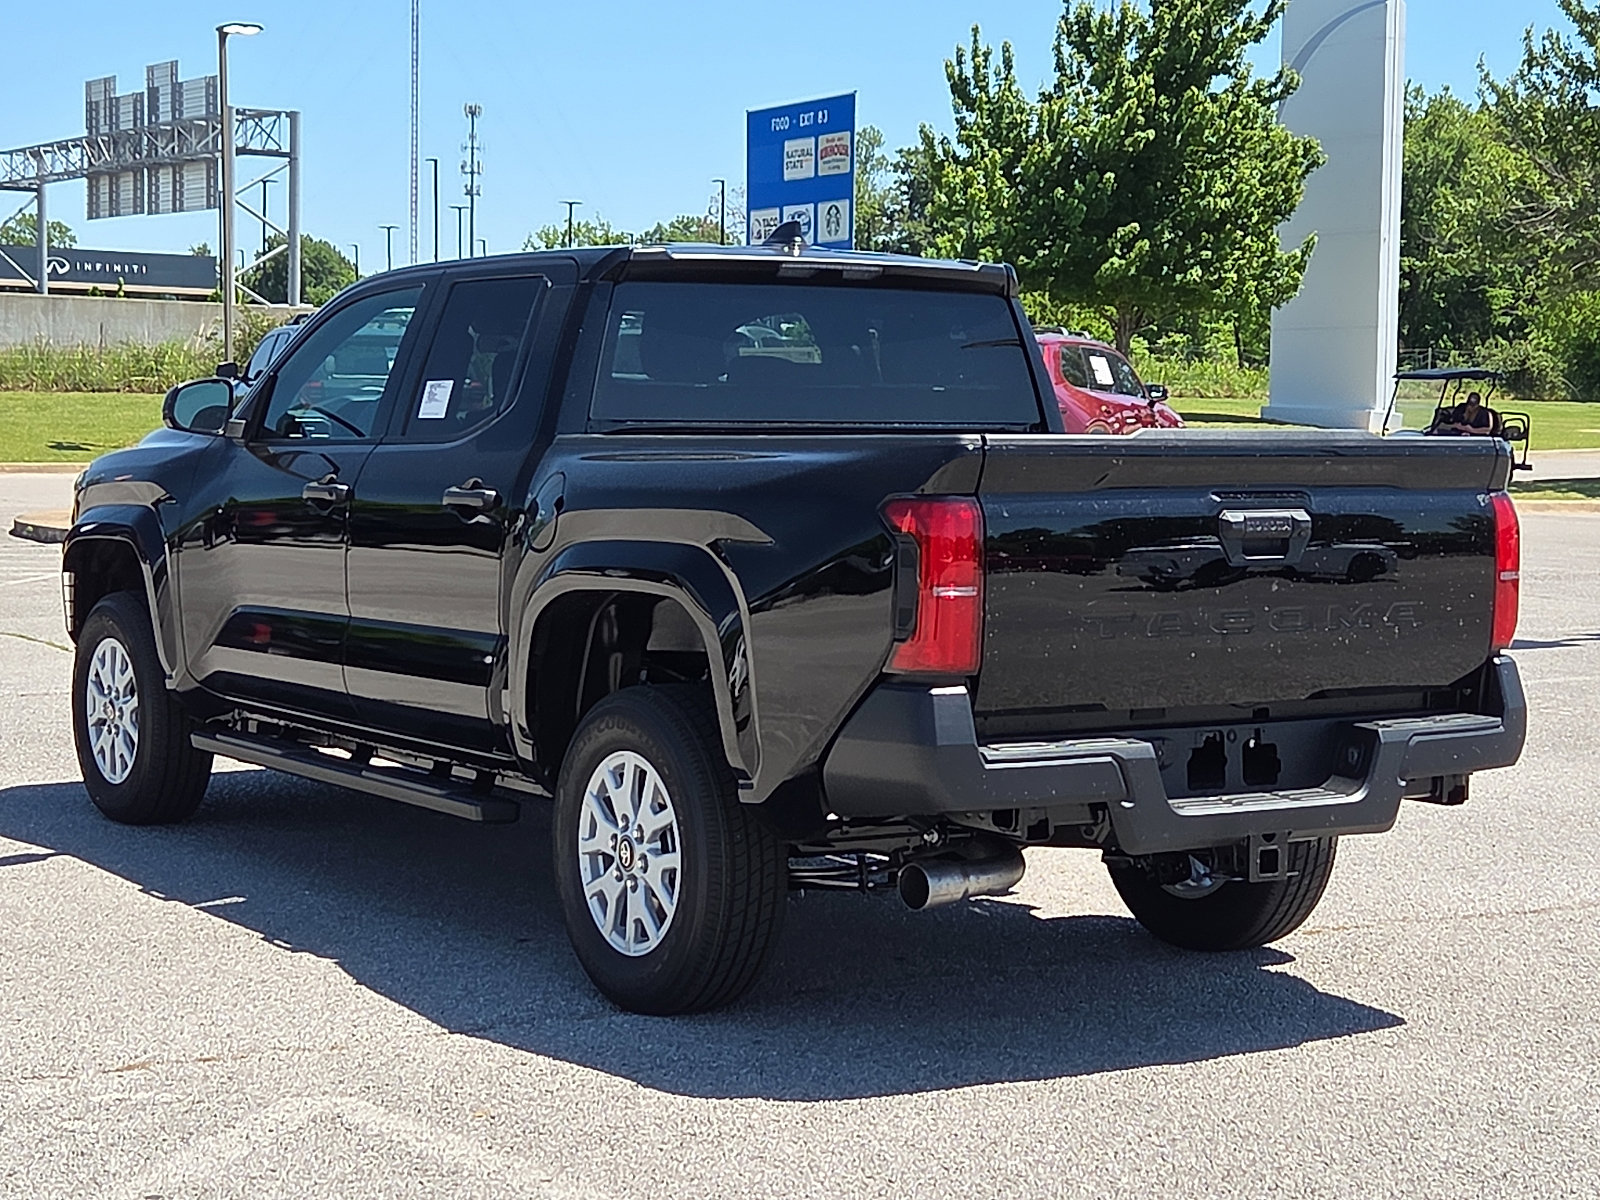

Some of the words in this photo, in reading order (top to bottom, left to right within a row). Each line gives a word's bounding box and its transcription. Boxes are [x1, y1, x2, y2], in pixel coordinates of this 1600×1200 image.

[771, 116, 790, 131] FOOD
[800, 112, 814, 127] EXIT
[786, 147, 813, 159] NATURAL
[786, 160, 804, 171] STATE
[763, 217, 778, 228] TACO
[76, 261, 147, 274] INFINITI
[1082, 601, 1424, 638] TACOMA
